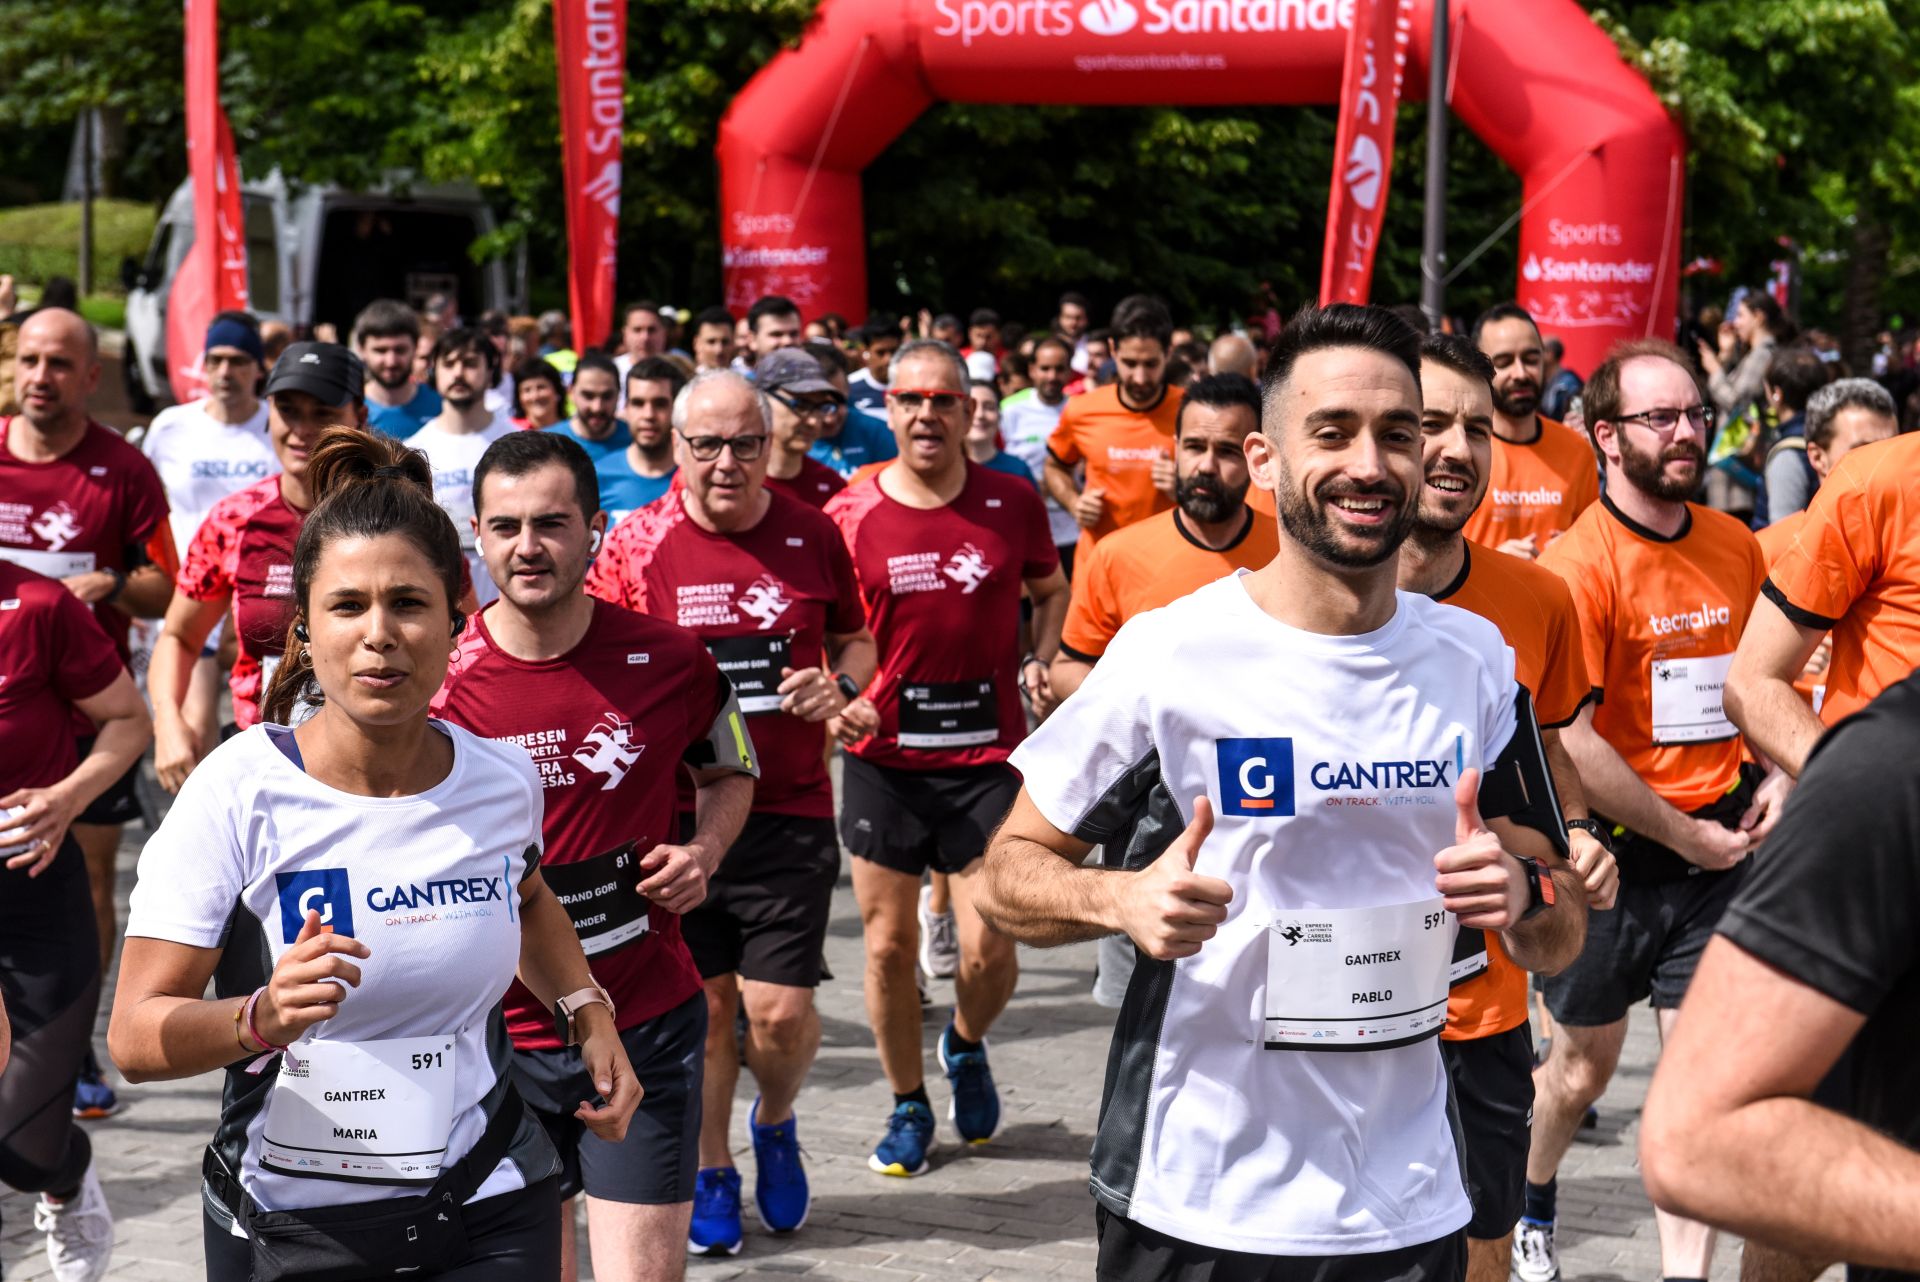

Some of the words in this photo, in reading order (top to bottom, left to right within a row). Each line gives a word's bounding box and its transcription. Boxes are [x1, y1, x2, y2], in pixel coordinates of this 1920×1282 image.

[934, 0, 1074, 47] Sports
[1143, 0, 1354, 34] Santande
[733, 211, 795, 236] Sports
[1548, 218, 1622, 249] Sports
[1541, 257, 1654, 283] Santander
[677, 583, 735, 597] ENPRESEN
[677, 605, 730, 617] CARRERA
[1238, 756, 1275, 799] G
[1310, 760, 1451, 790] GANTREX
[1326, 797, 1343, 807] ON
[1346, 797, 1382, 807] TRACK.
[1385, 796, 1414, 805] WITH
[616, 852, 630, 869] 81
[366, 877, 502, 913] GANTREX
[594, 881, 618, 897] GORI
[298, 886, 334, 925] G
[385, 917, 402, 927] ON
[405, 913, 442, 924] TRACK.
[443, 909, 472, 920] WITH
[573, 913, 607, 929] ANDER
[1424, 910, 1446, 930] 591
[1345, 950, 1401, 966] GANTREX
[1351, 990, 1393, 1004] PABLO
[411, 1052, 443, 1070] 591
[324, 1088, 386, 1102] GANTREX
[333, 1127, 378, 1140] MARIA
